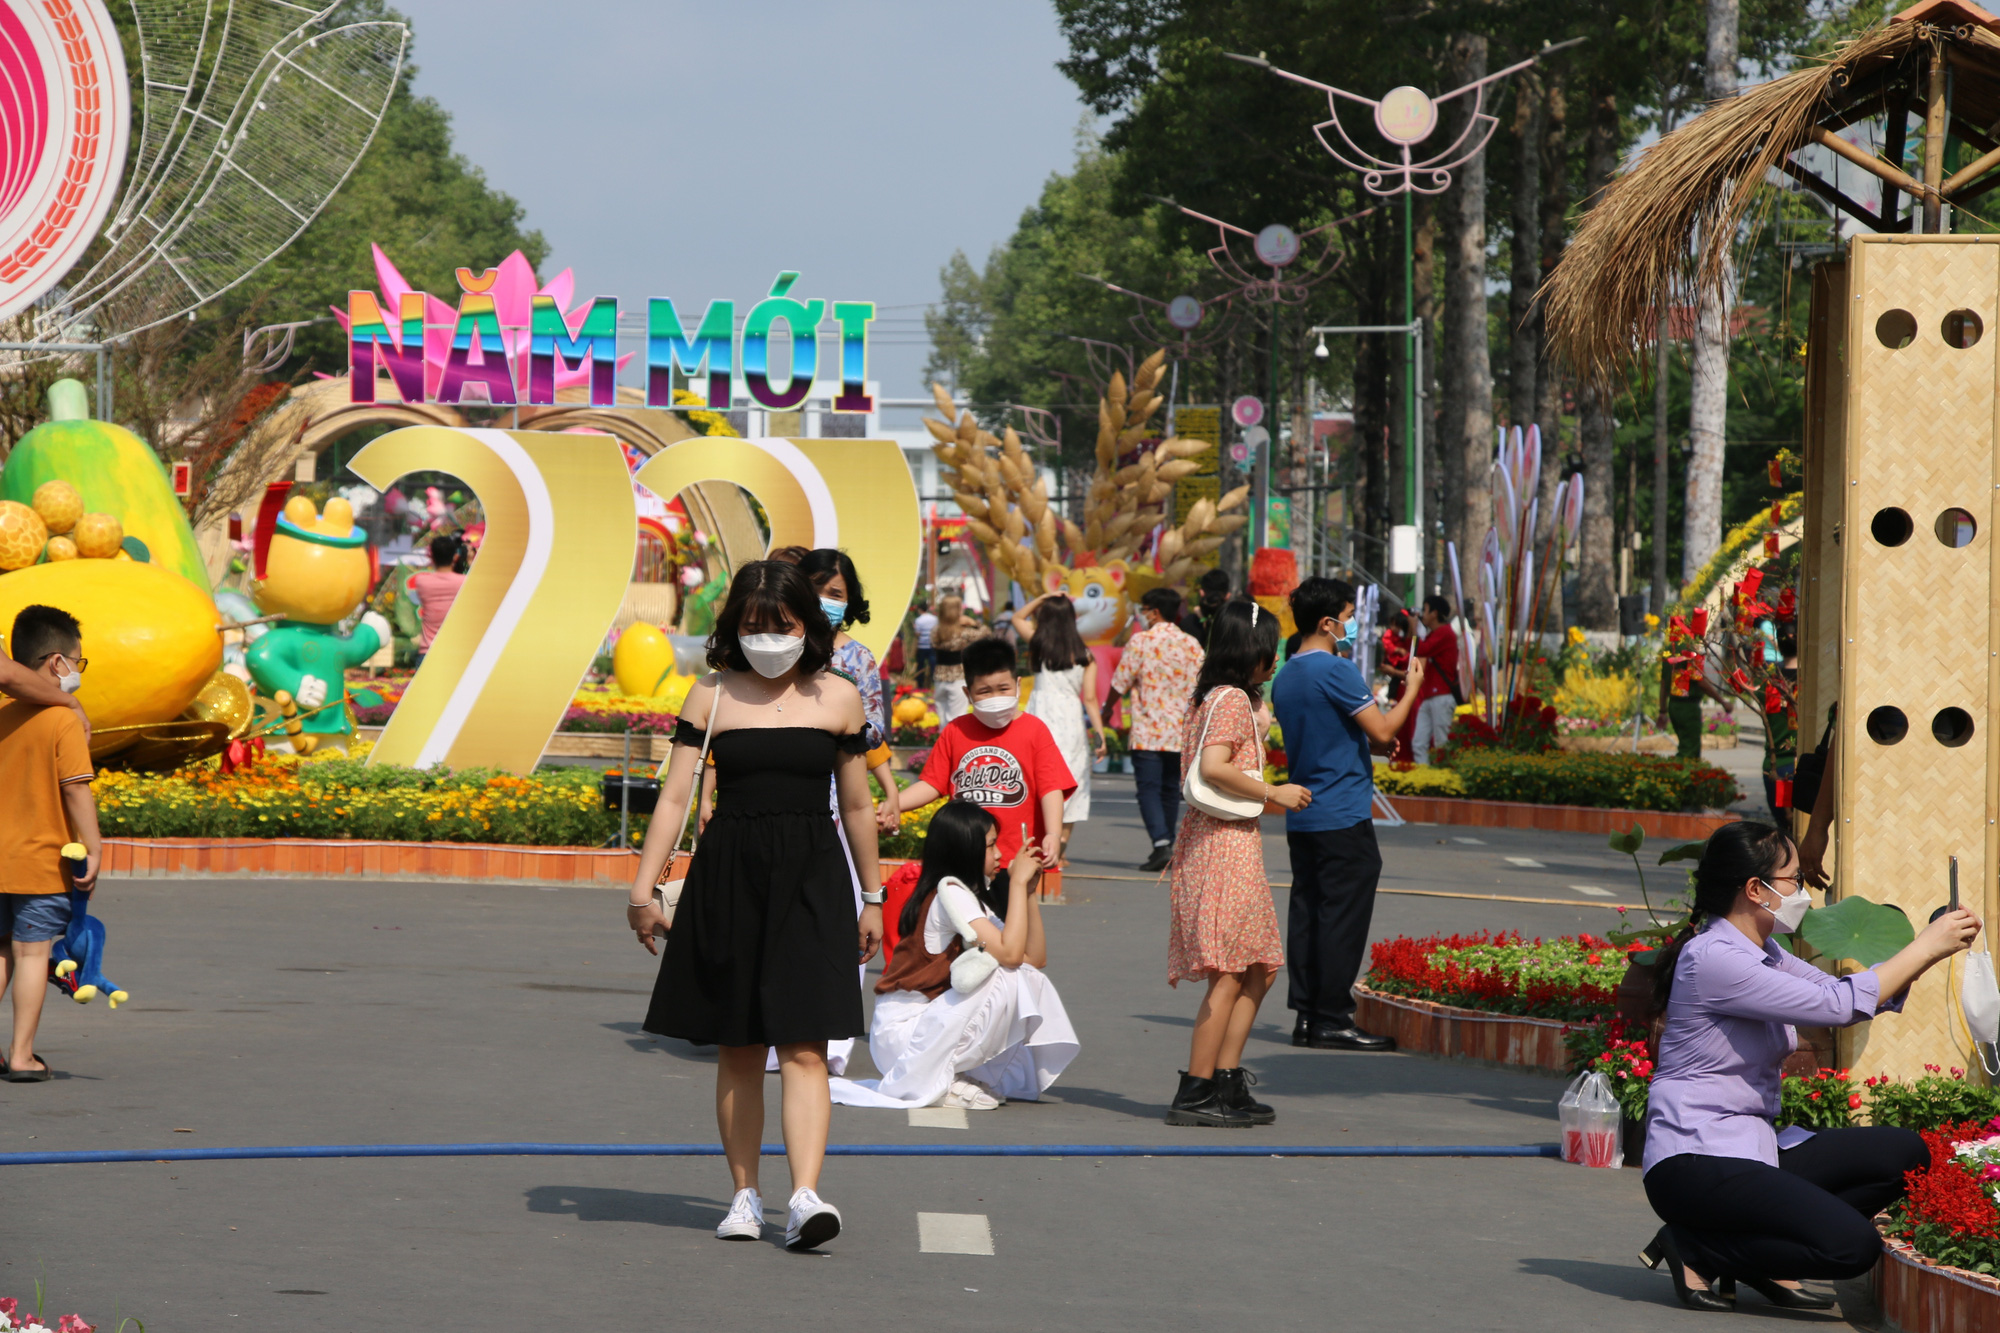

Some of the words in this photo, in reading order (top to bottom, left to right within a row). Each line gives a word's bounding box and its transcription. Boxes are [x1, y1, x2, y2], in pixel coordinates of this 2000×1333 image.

[347, 268, 618, 406] NĂM
[645, 270, 875, 412] MỚI
[961, 747, 999, 764] THOUSAND
[999, 750, 1017, 766] OAKS
[952, 767, 986, 789] Field
[986, 765, 1020, 788] Day
[962, 790, 1004, 803] 2019
